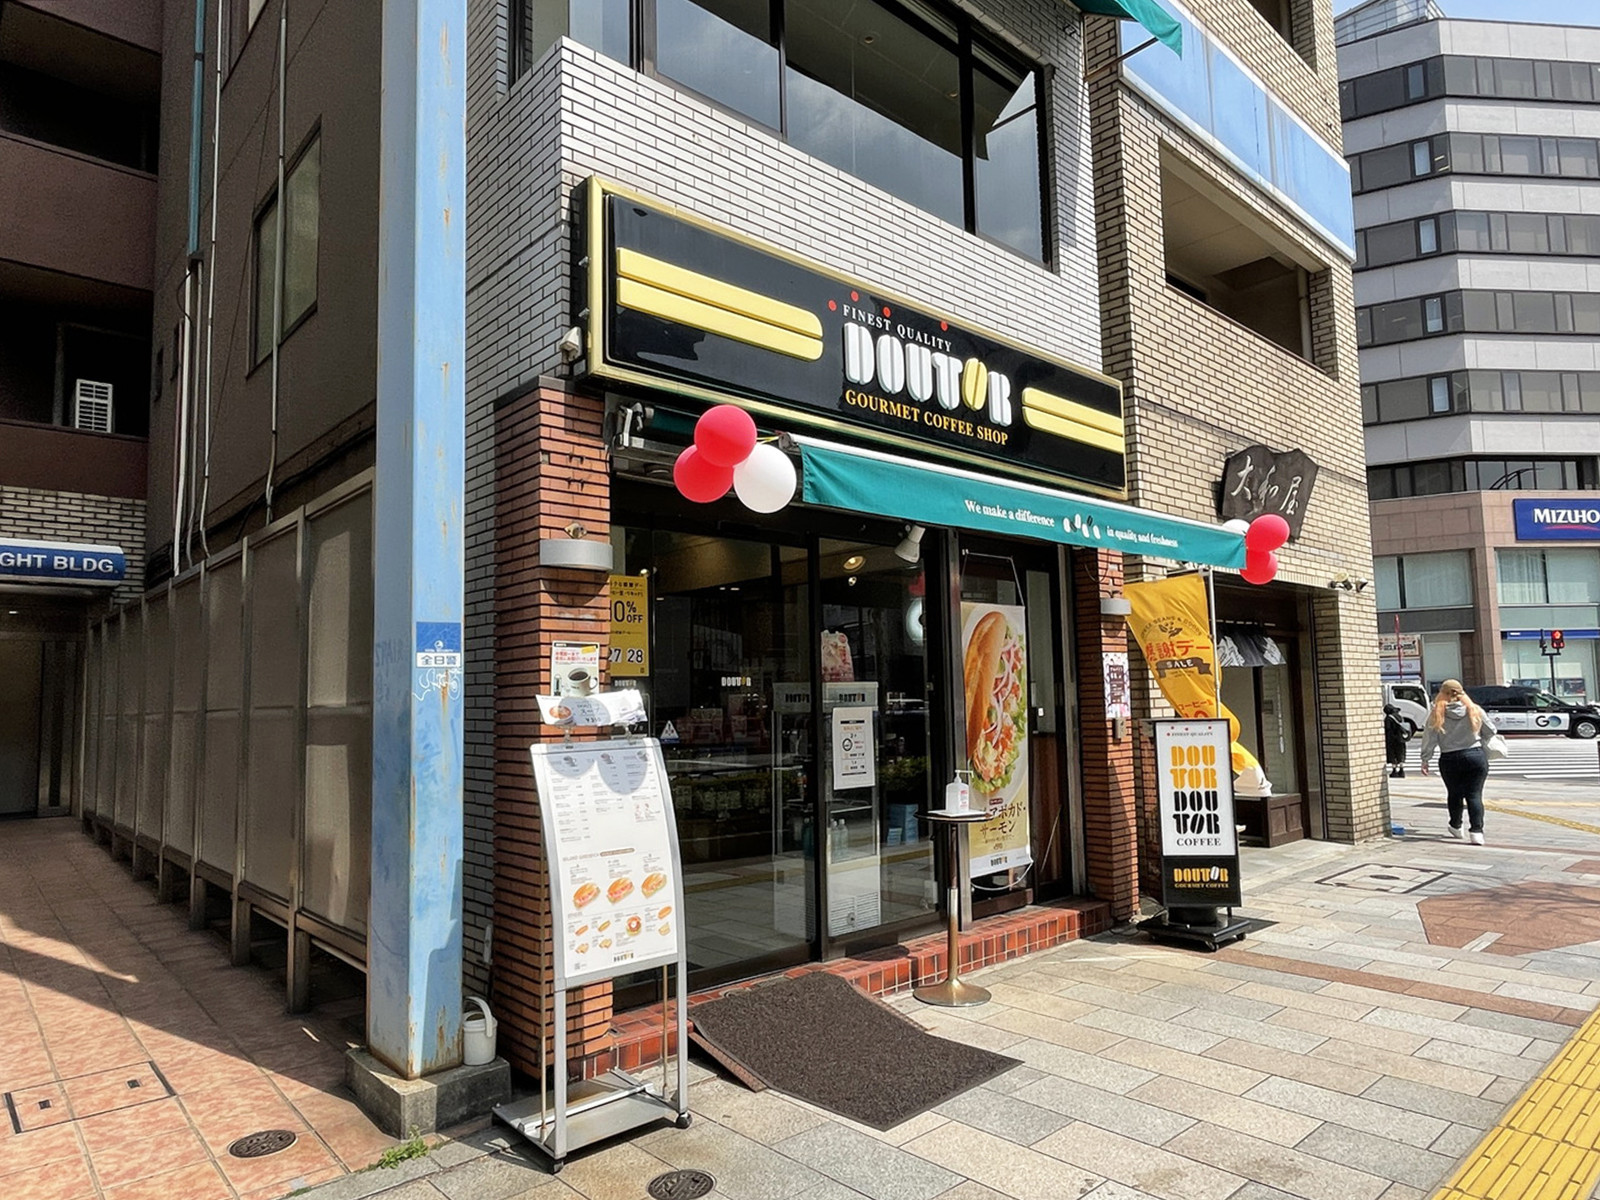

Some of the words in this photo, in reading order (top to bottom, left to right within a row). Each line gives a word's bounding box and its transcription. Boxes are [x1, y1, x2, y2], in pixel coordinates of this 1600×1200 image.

[843, 304, 892, 331] FINEST
[897, 324, 952, 352] QUALITY
[843, 321, 1013, 427] DOUTOR
[845, 389, 919, 422] GOURMET
[924, 410, 974, 437] COFFEE
[977, 425, 1008, 446] SHOP
[964, 499, 981, 514] We
[983, 505, 1007, 519] make
[1008, 511, 1015, 520] a
[1015, 509, 1055, 527] difference
[1534, 508, 1600, 524] MIZUHO
[1106, 525, 1114, 537] in
[1115, 529, 1138, 543] quality
[1138, 533, 1151, 543] and
[1150, 533, 1179, 548] freshness
[0, 552, 47, 568] GHT
[53, 556, 118, 574] BLDG.
[626, 614, 644, 624] OFF
[627, 648, 644, 663] 28
[1145, 639, 1210, 661] 感謝デー
[1166, 659, 1194, 668] SALE
[721, 676, 751, 687] DOUTOR
[1535, 715, 1562, 728] GO
[1171, 745, 1216, 767] DOU
[1170, 767, 1218, 789] TOR
[1173, 790, 1218, 812] DOU
[980, 820, 1016, 838] サーモン
[1172, 813, 1220, 835] TOR
[1176, 837, 1222, 847] COFFEE
[1173, 866, 1229, 883] DOUTOR
